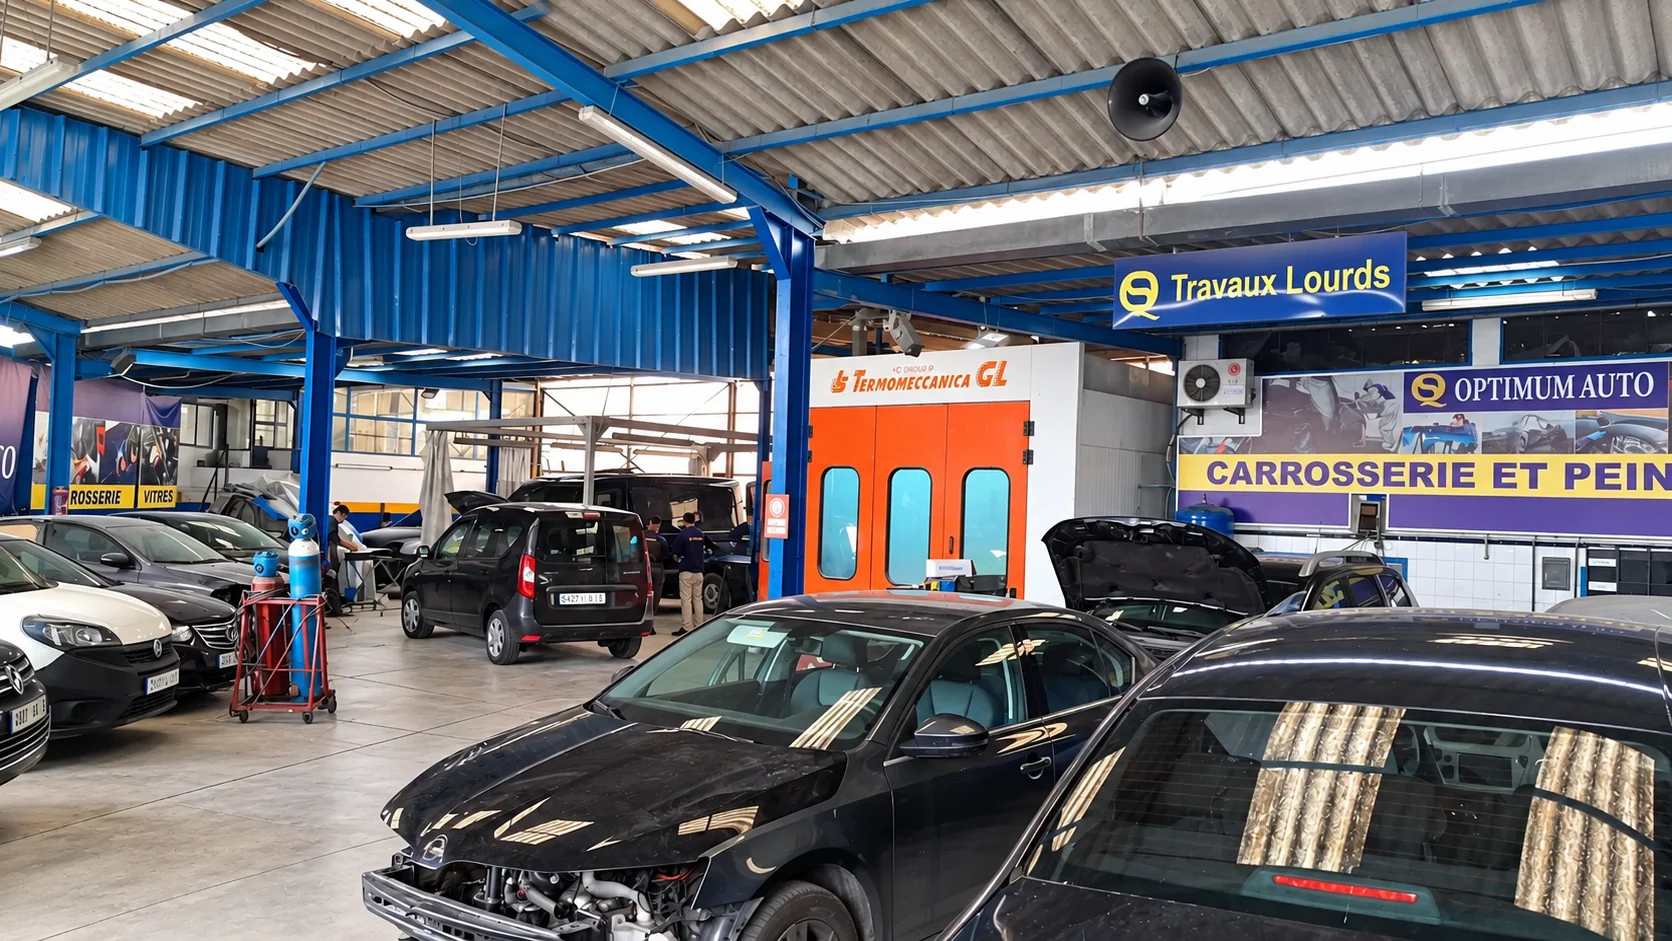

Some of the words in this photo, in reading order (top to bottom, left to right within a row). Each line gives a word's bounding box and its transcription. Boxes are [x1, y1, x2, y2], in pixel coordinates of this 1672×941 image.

[1171, 273, 1277, 302] Travaux
[1286, 259, 1391, 295] Lourds
[853, 369, 971, 393] TERMOMECCANICA
[975, 360, 1008, 387] GL
[1454, 375, 1575, 402] OPTIMUM
[1579, 371, 1655, 399] AUTO
[1206, 460, 1476, 489] CARROSSERIE
[1493, 462, 1548, 490] ET
[70, 490, 122, 505] ROSSERIE
[144, 490, 174, 504] VITRES
